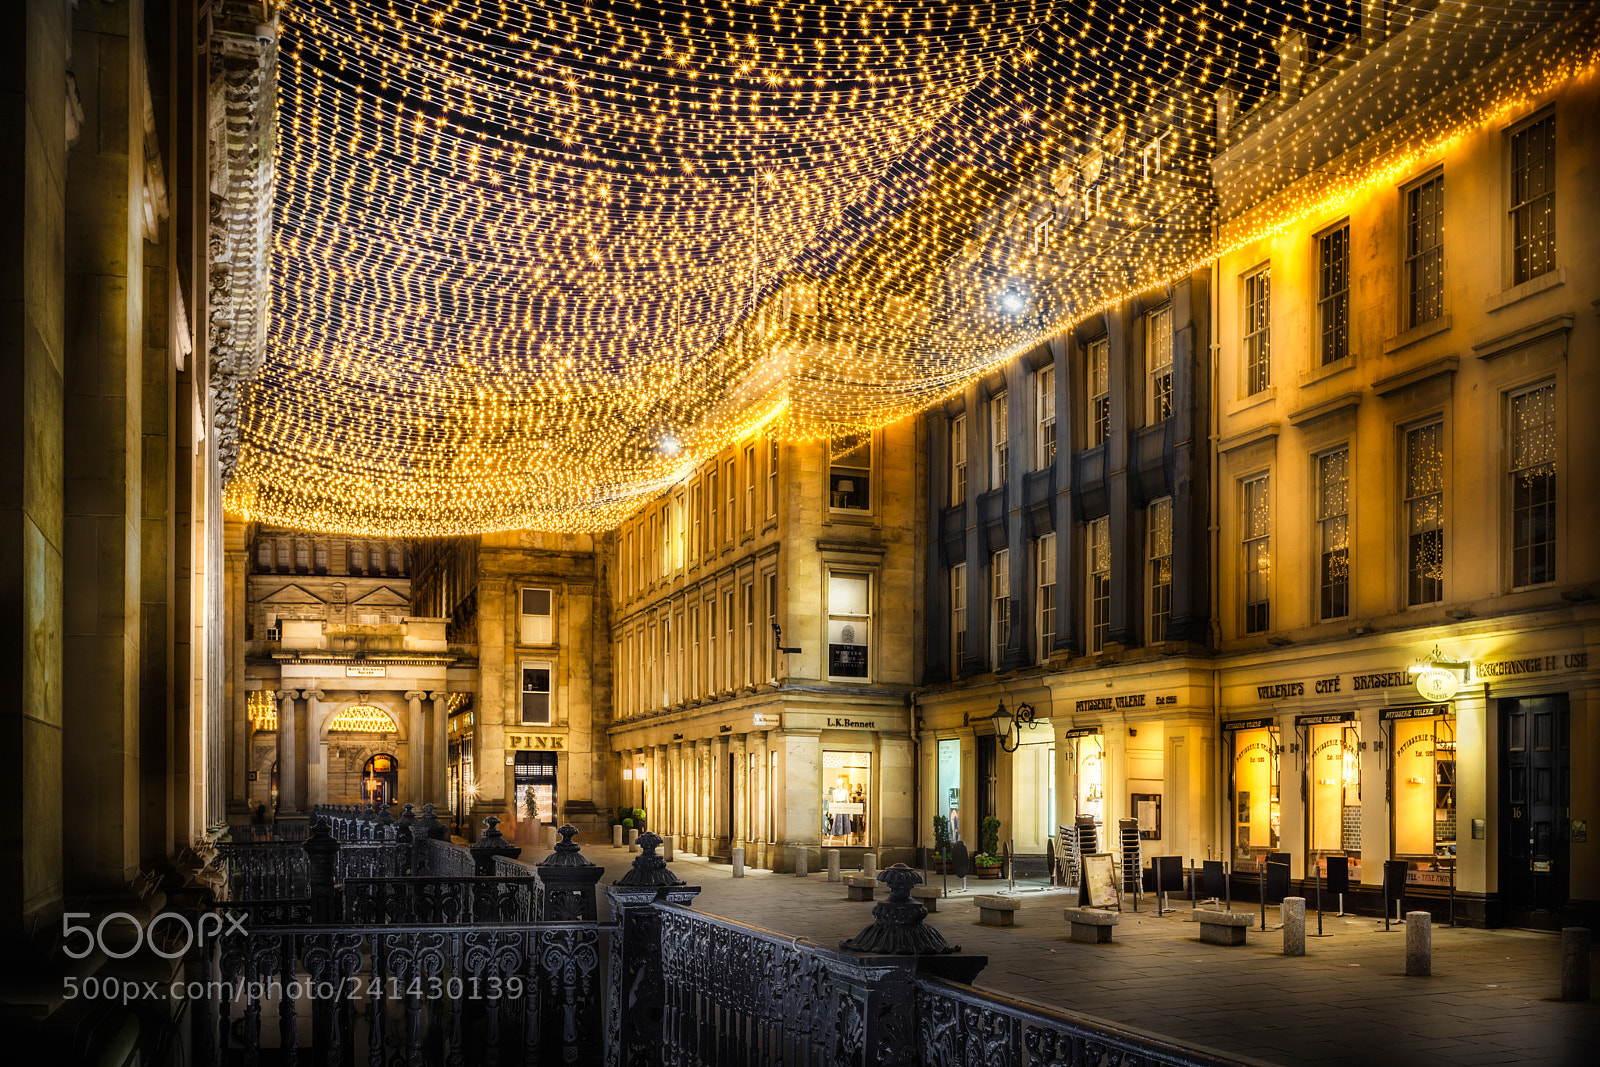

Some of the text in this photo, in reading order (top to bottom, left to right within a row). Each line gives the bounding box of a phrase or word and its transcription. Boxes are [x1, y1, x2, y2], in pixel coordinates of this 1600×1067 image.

[1475, 657, 1542, 678] EXCHANGE
[1257, 671, 1414, 700] VALERIE'S CAFÉ BRASSERIE
[1075, 697, 1113, 712] PATISSERIE
[1115, 694, 1146, 708] VALERIE
[827, 718, 875, 729] L.K.Bennett
[510, 736, 564, 749] PINK
[1513, 806, 1522, 818] 16
